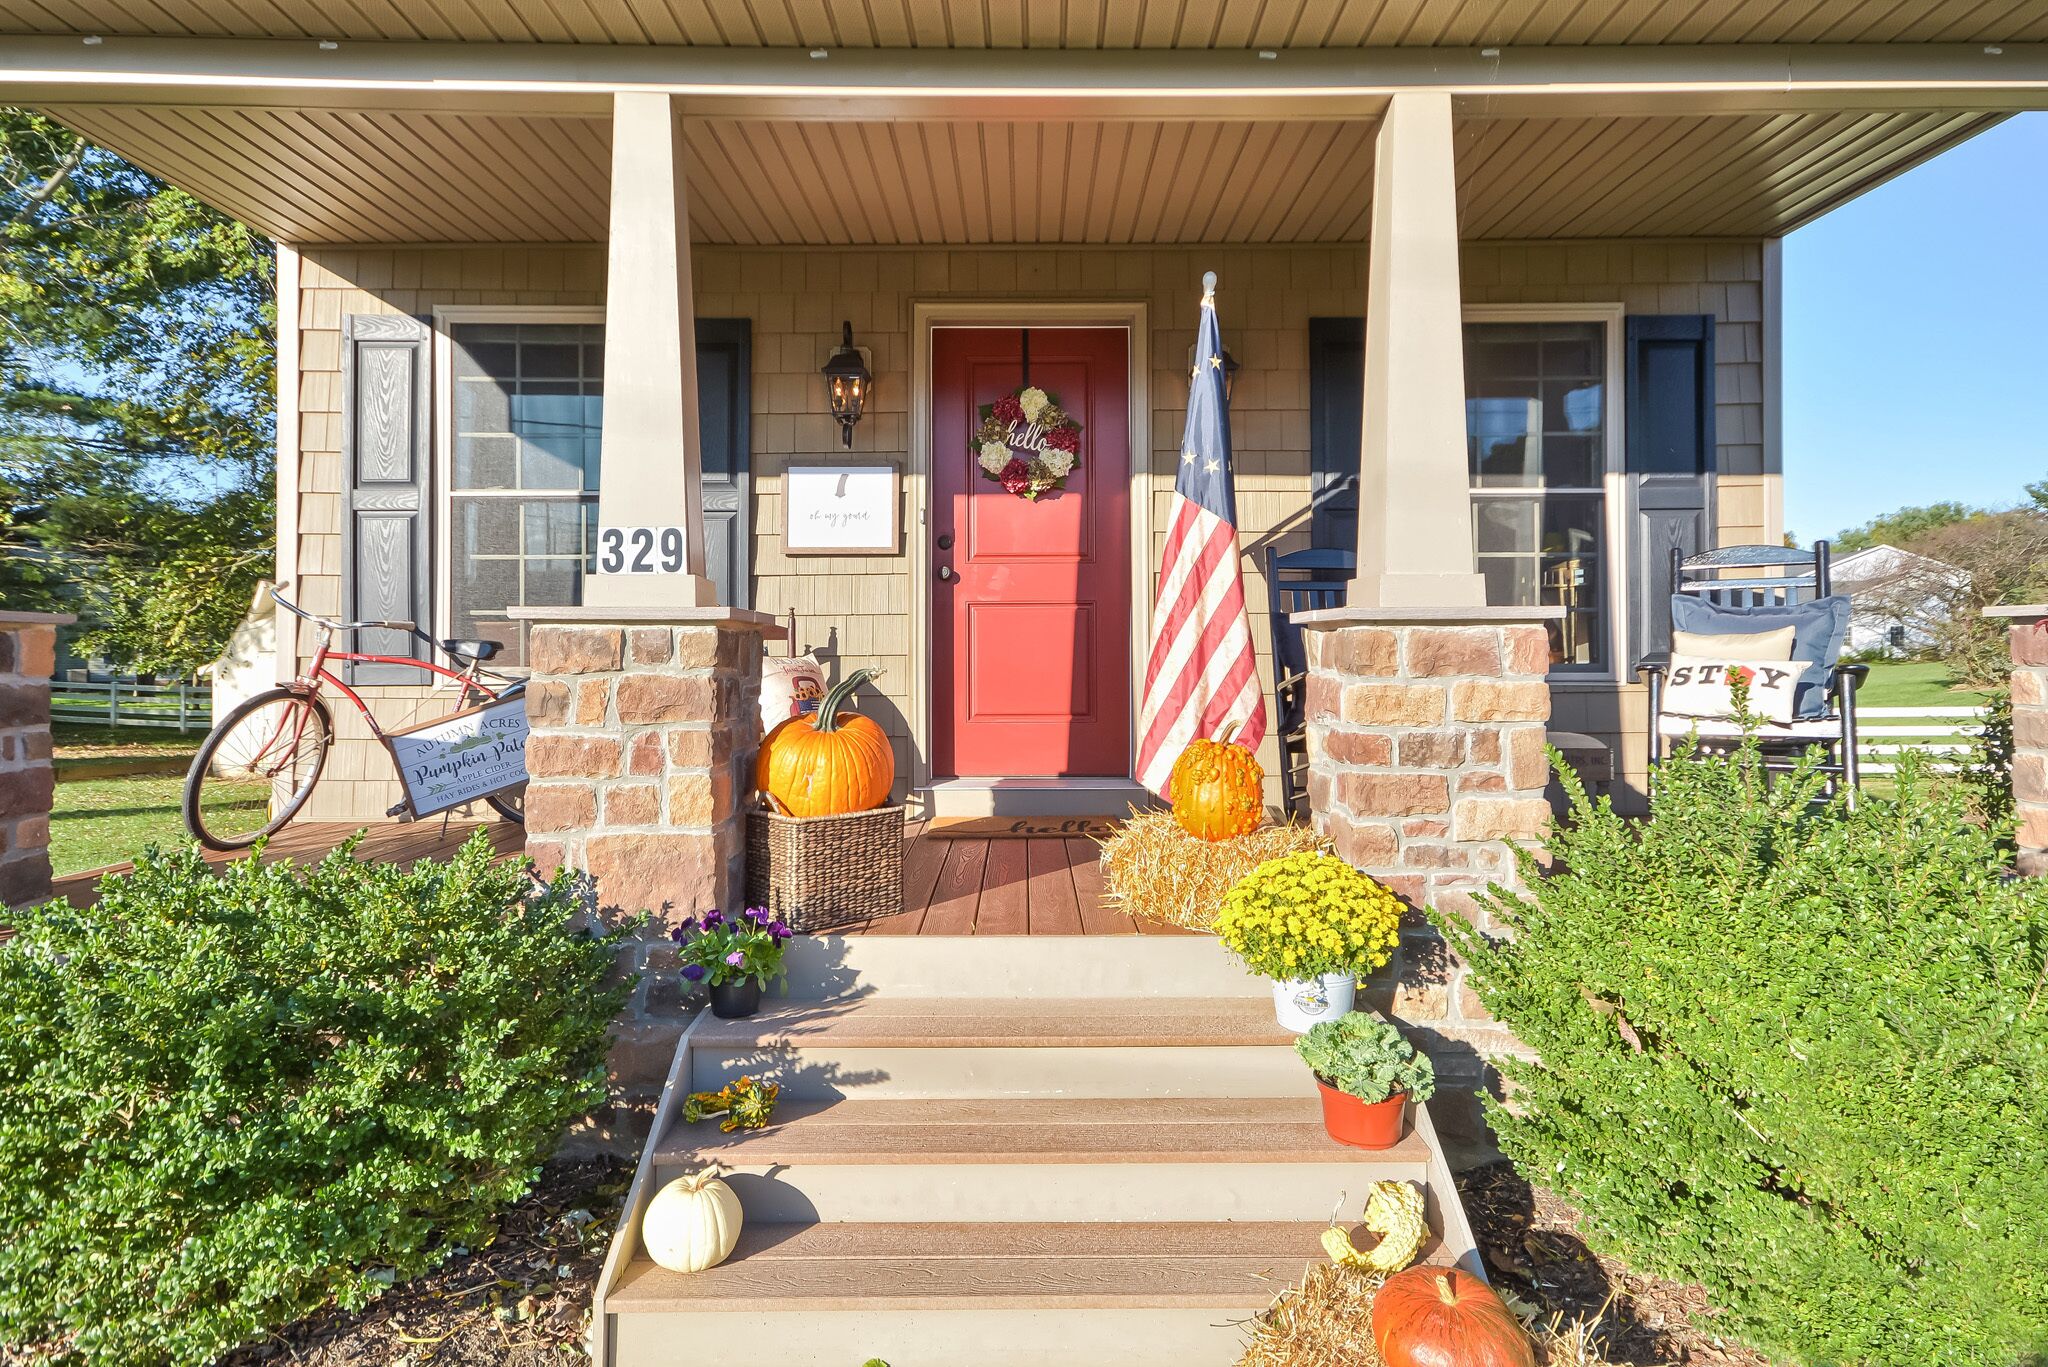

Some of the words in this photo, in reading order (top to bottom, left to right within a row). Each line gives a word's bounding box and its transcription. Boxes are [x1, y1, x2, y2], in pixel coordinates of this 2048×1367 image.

[1003, 419, 1052, 452] hello
[809, 510, 822, 521] oh
[824, 513, 840, 528] my
[842, 511, 872, 528] gourd
[601, 527, 683, 574] 329
[416, 721, 475, 758] AUTUMN
[480, 718, 521, 730] ACRES
[414, 751, 489, 786] Pumpkin
[491, 737, 526, 762] Patc
[456, 770, 483, 785] APPLE
[484, 761, 512, 776] CIDER
[436, 791, 456, 804] HAY
[458, 783, 481, 797] RIDES
[482, 780, 489, 788] &
[490, 774, 507, 786] HOT
[509, 768, 527, 779] COC
[1008, 820, 1112, 834] hello
